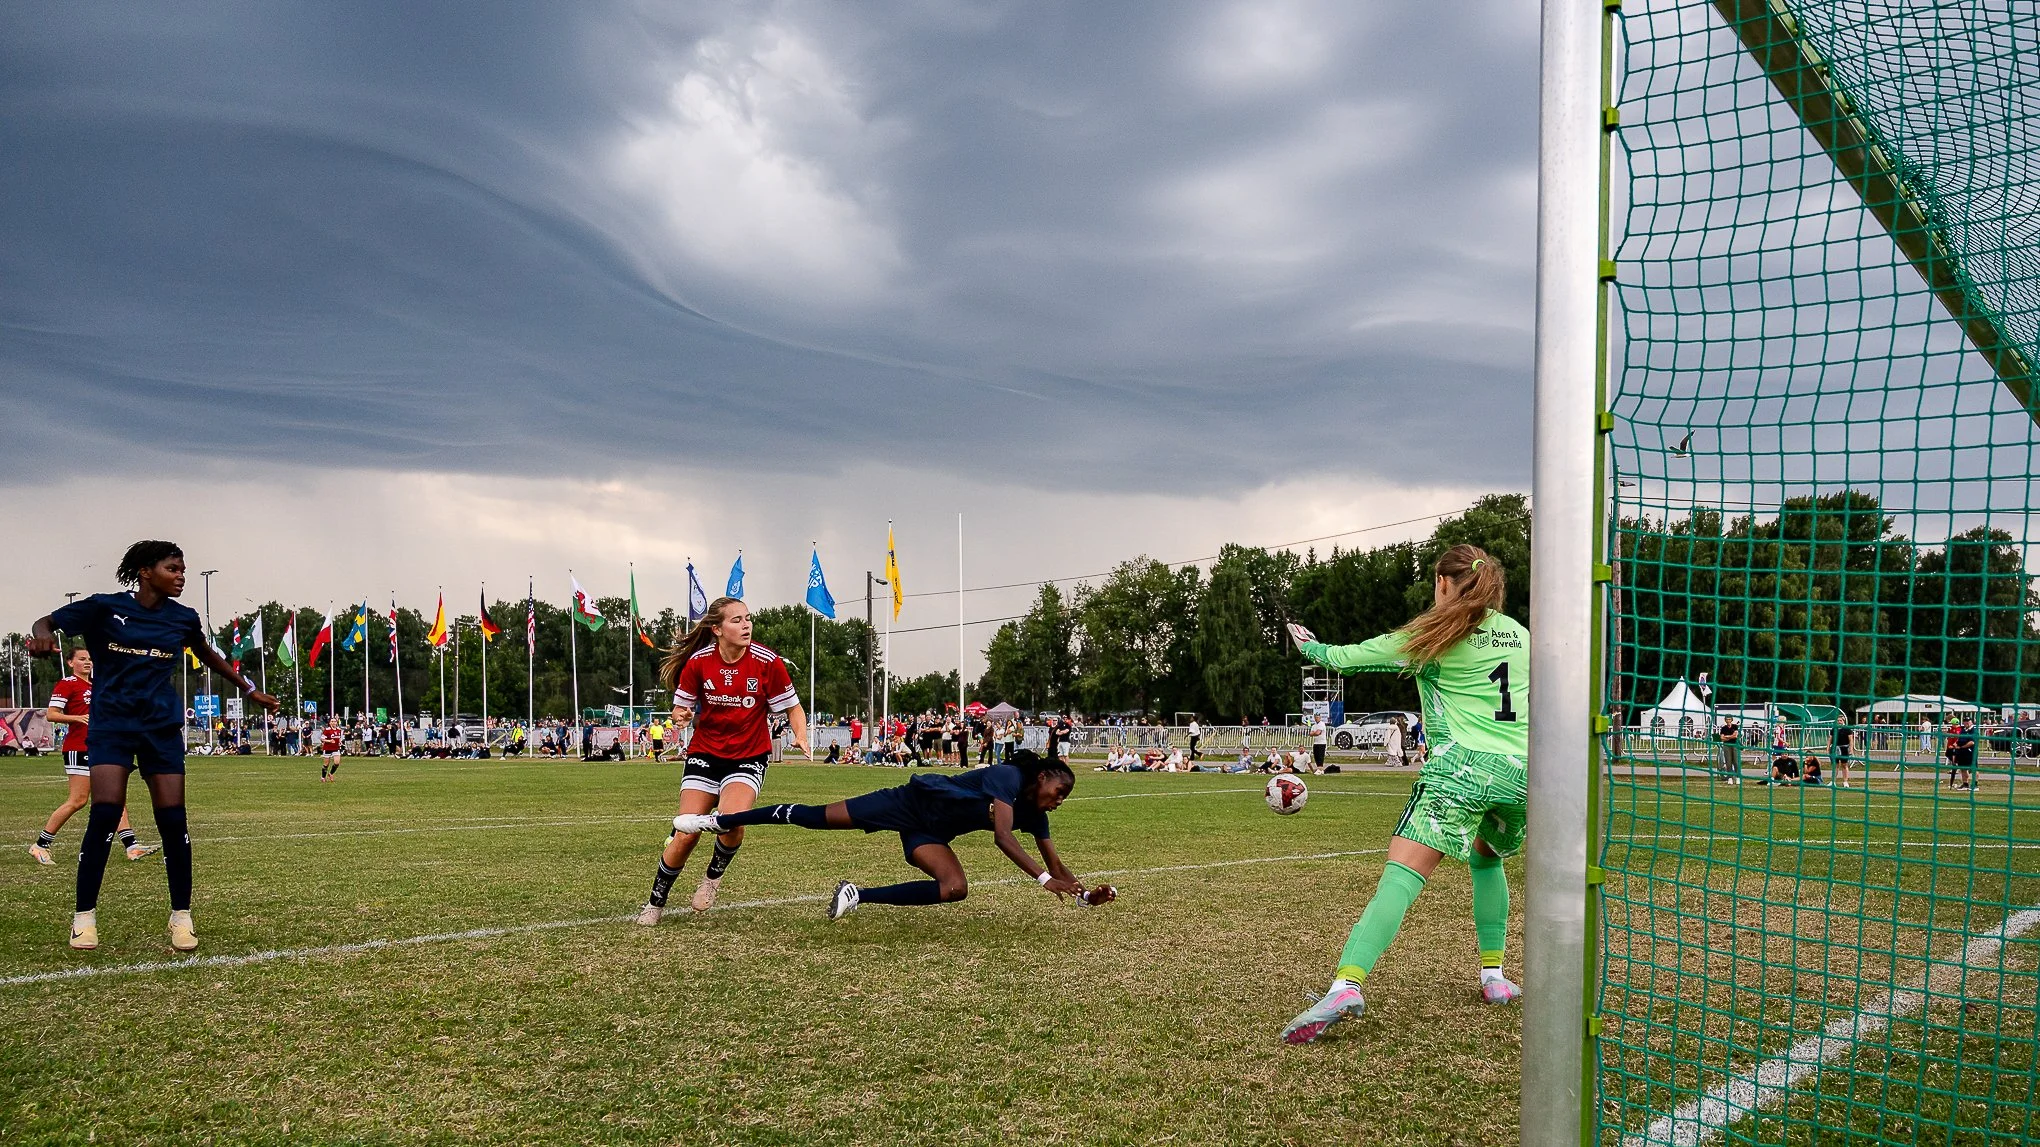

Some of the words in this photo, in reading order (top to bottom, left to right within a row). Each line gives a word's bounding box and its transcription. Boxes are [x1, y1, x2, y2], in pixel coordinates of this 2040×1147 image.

[1491, 627, 1511, 639] Åsen
[1491, 639, 1522, 649] Øvrelid
[1488, 661, 1516, 721] 1
[704, 692, 742, 703] SpareBank
[105, 832, 114, 842] 2
